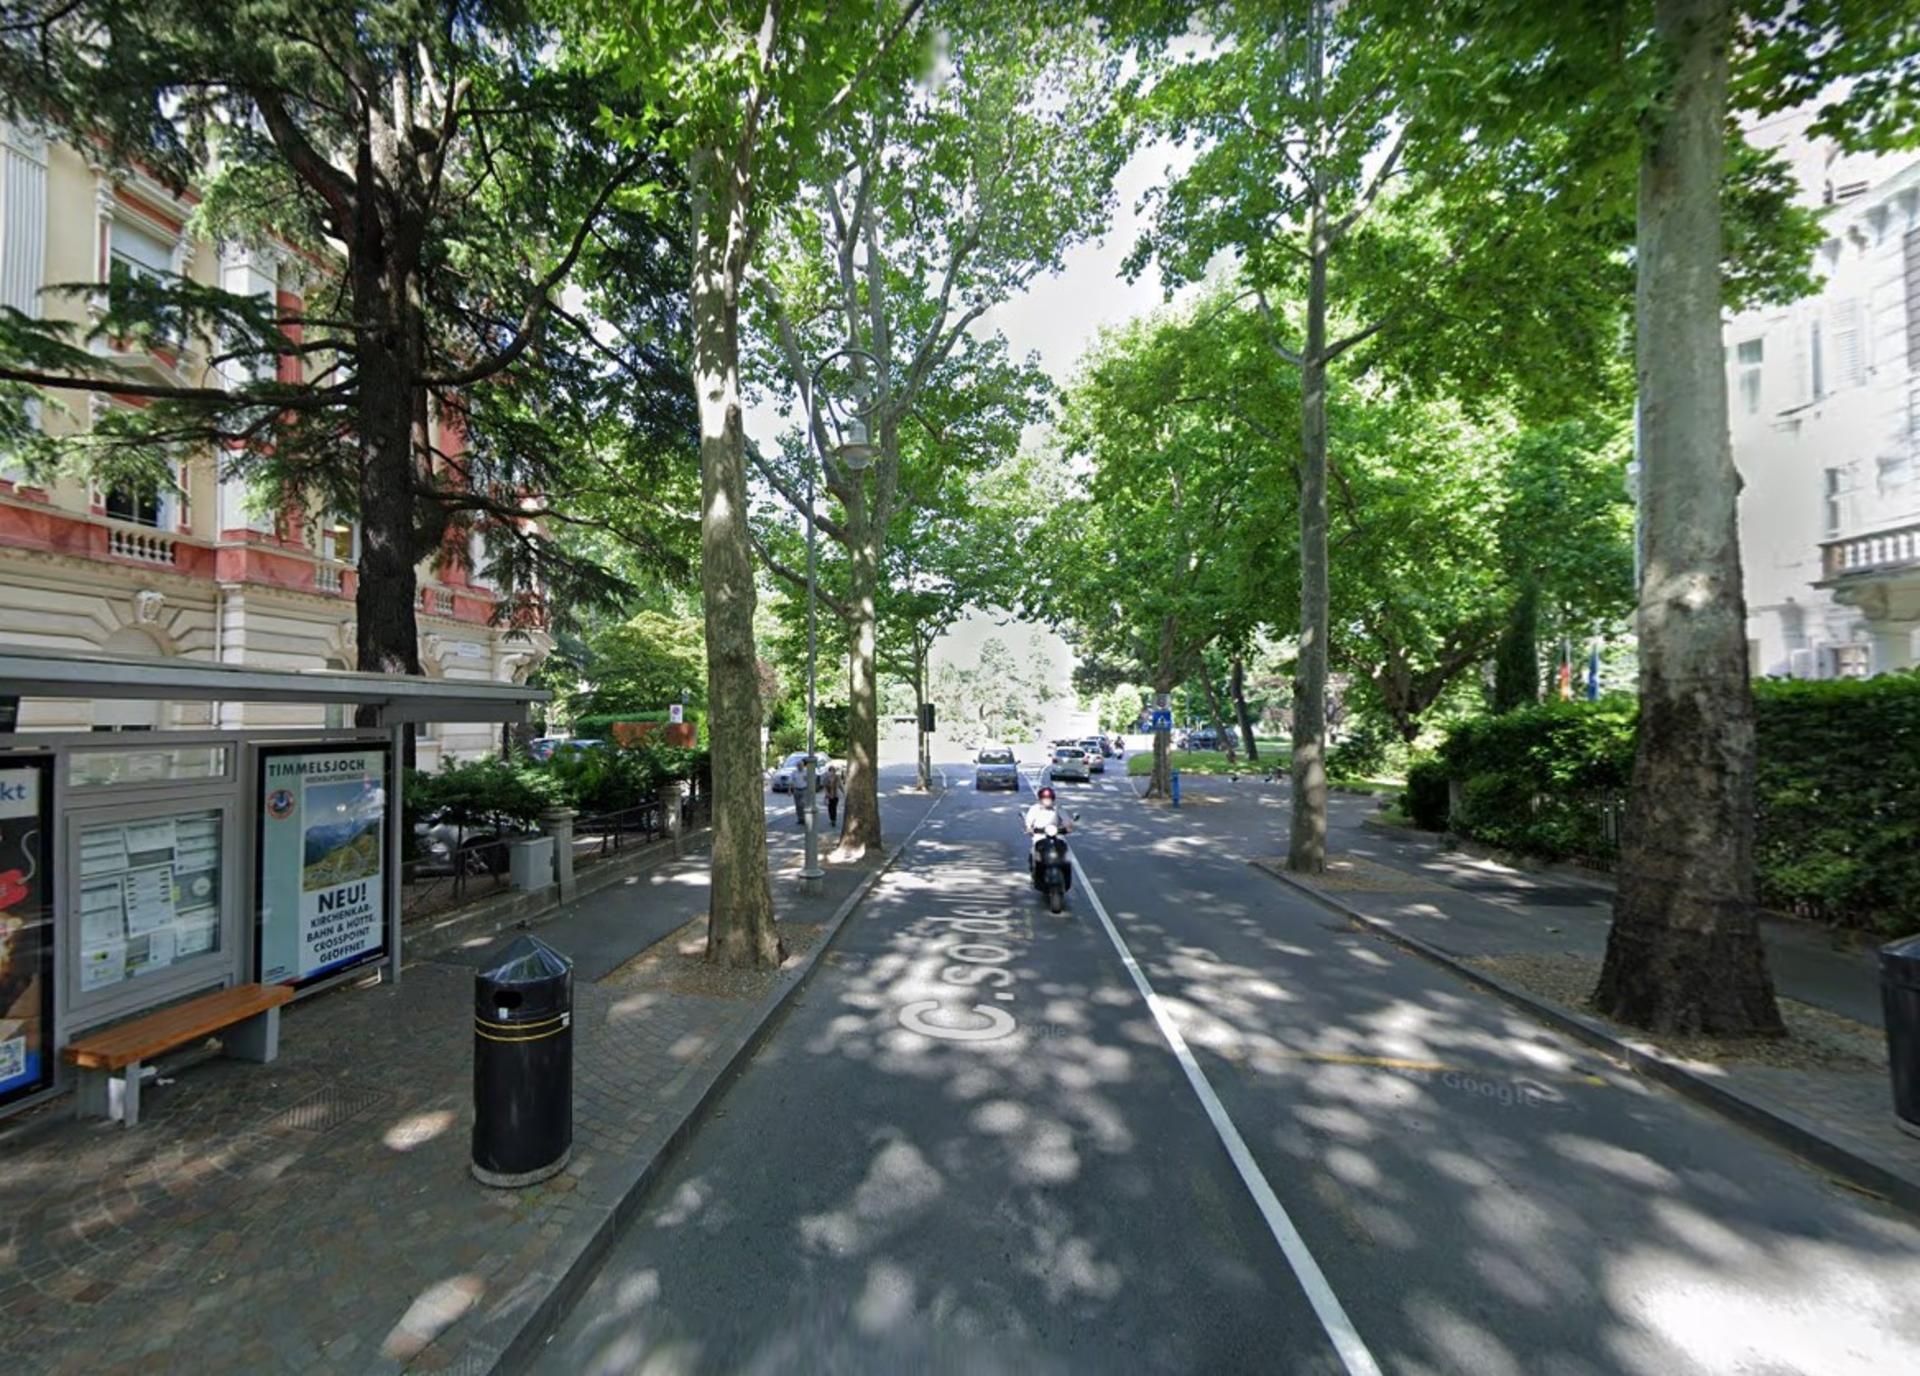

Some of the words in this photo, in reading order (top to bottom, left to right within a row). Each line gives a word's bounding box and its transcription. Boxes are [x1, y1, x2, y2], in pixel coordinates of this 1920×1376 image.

[268, 760, 365, 777] TIMMELSJOCH
[318, 883, 366, 913] NEU!
[307, 926, 334, 942] BAHN
[337, 923, 344, 933] &
[313, 926, 370, 953] CROSSPOINT
